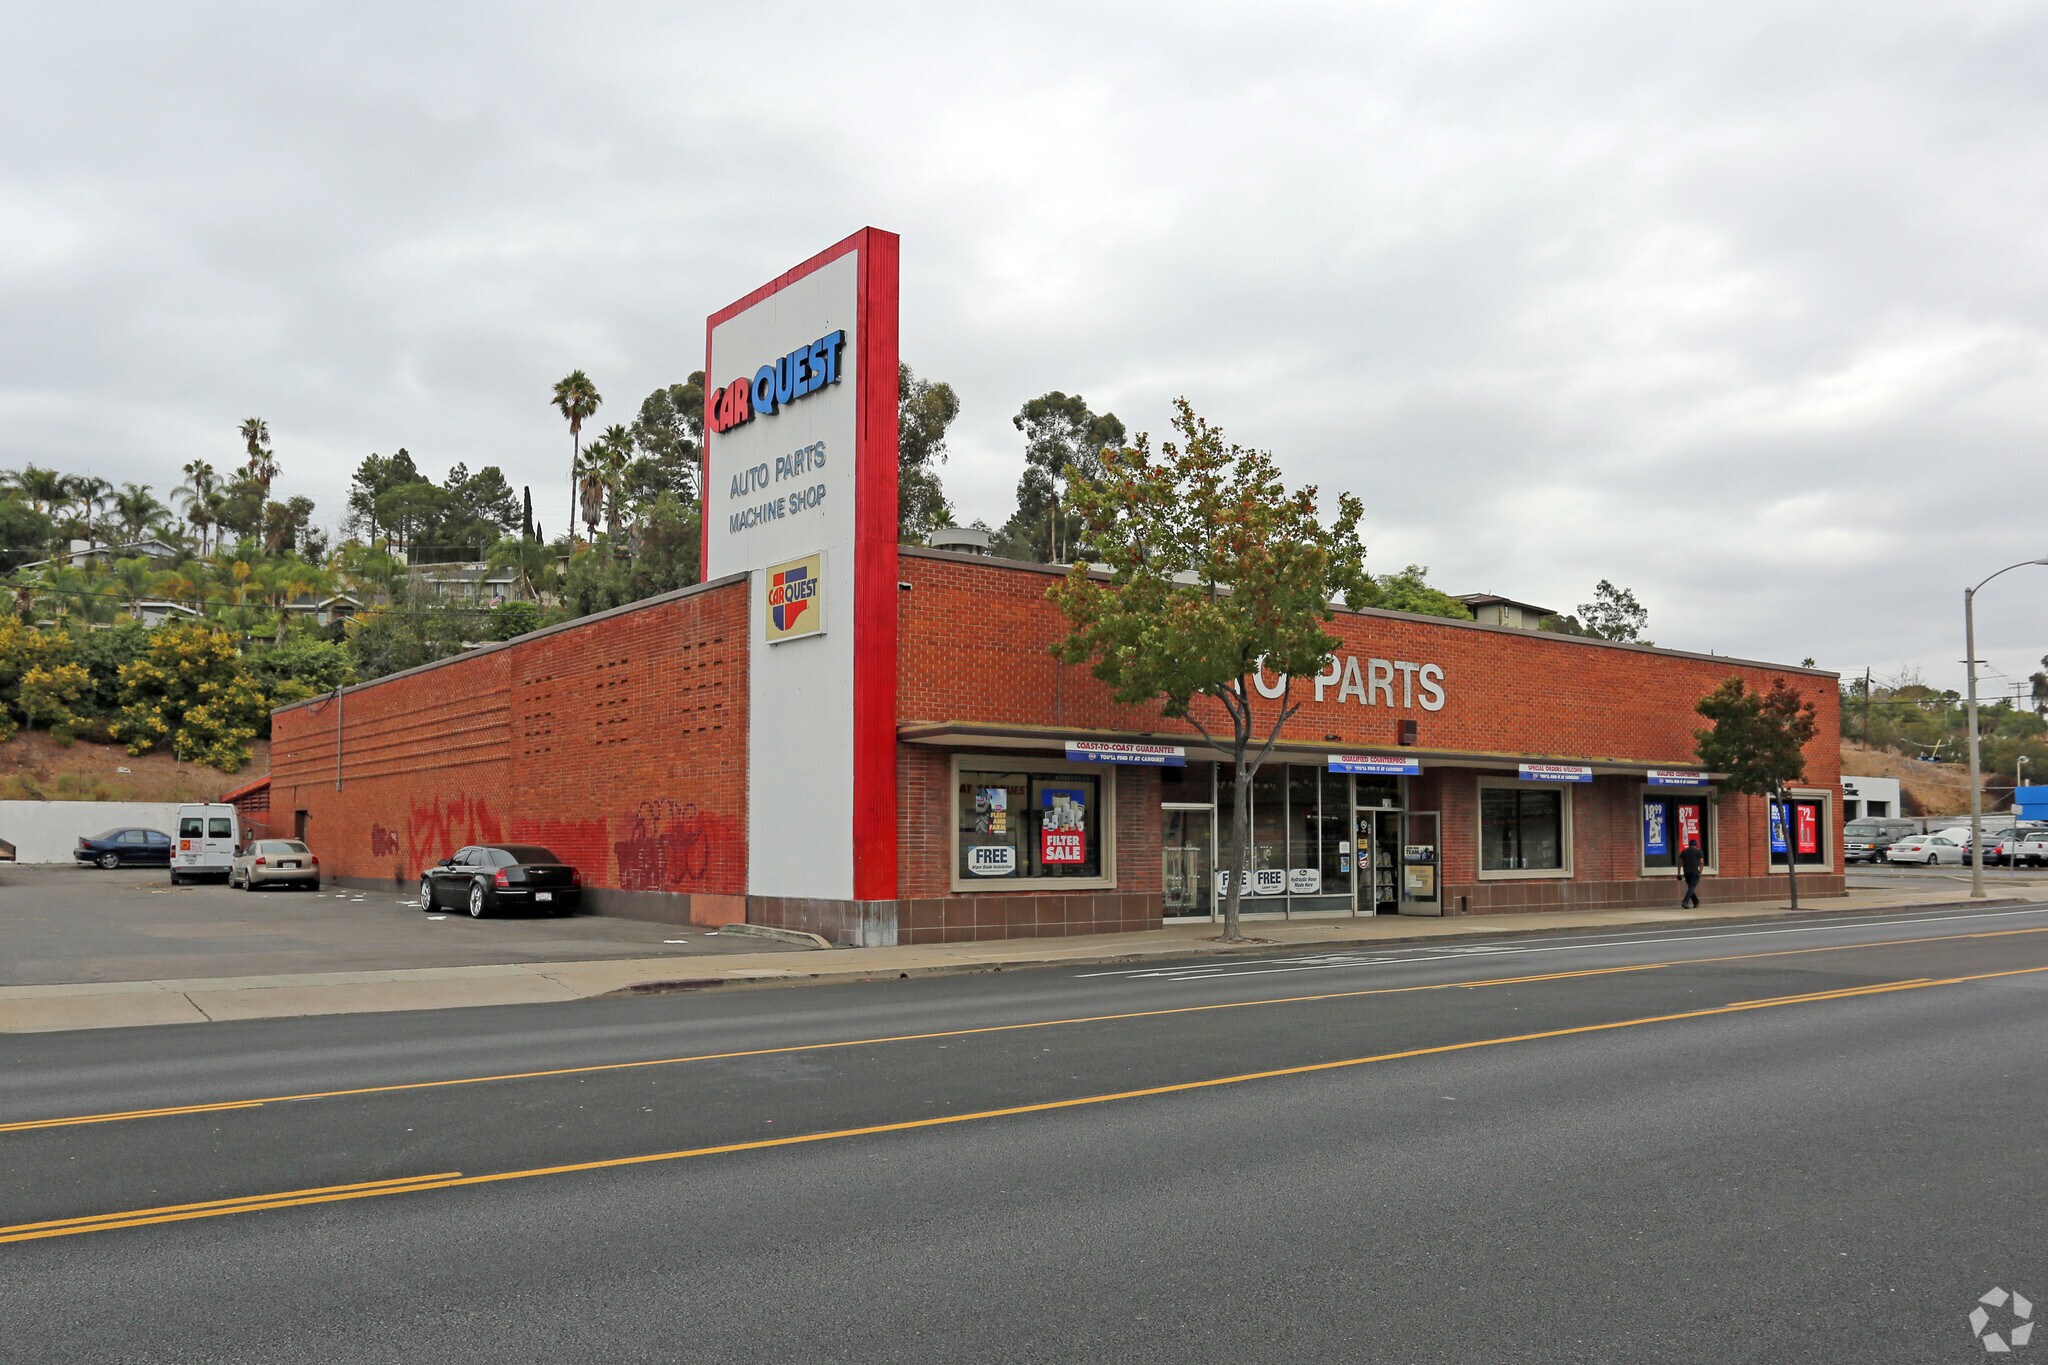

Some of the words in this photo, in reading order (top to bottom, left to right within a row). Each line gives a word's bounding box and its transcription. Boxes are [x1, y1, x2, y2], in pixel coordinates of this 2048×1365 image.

[730, 463, 769, 499] AUTO
[775, 440, 826, 482] PARTS
[729, 497, 785, 534] MACHINE
[788, 484, 826, 515] SHOP
[1314, 653, 1446, 712] PARTS
[1076, 742, 1134, 752] COAST-TO-COAST
[1136, 745, 1175, 754] GUARANTEE
[1341, 755, 1369, 763] QUALIFIED
[1046, 836, 1080, 846] FILTER
[976, 849, 1007, 863] FREE
[1046, 846, 1080, 860] SALE
[1222, 873, 1247, 885] FE
[1258, 871, 1281, 884] FREE
